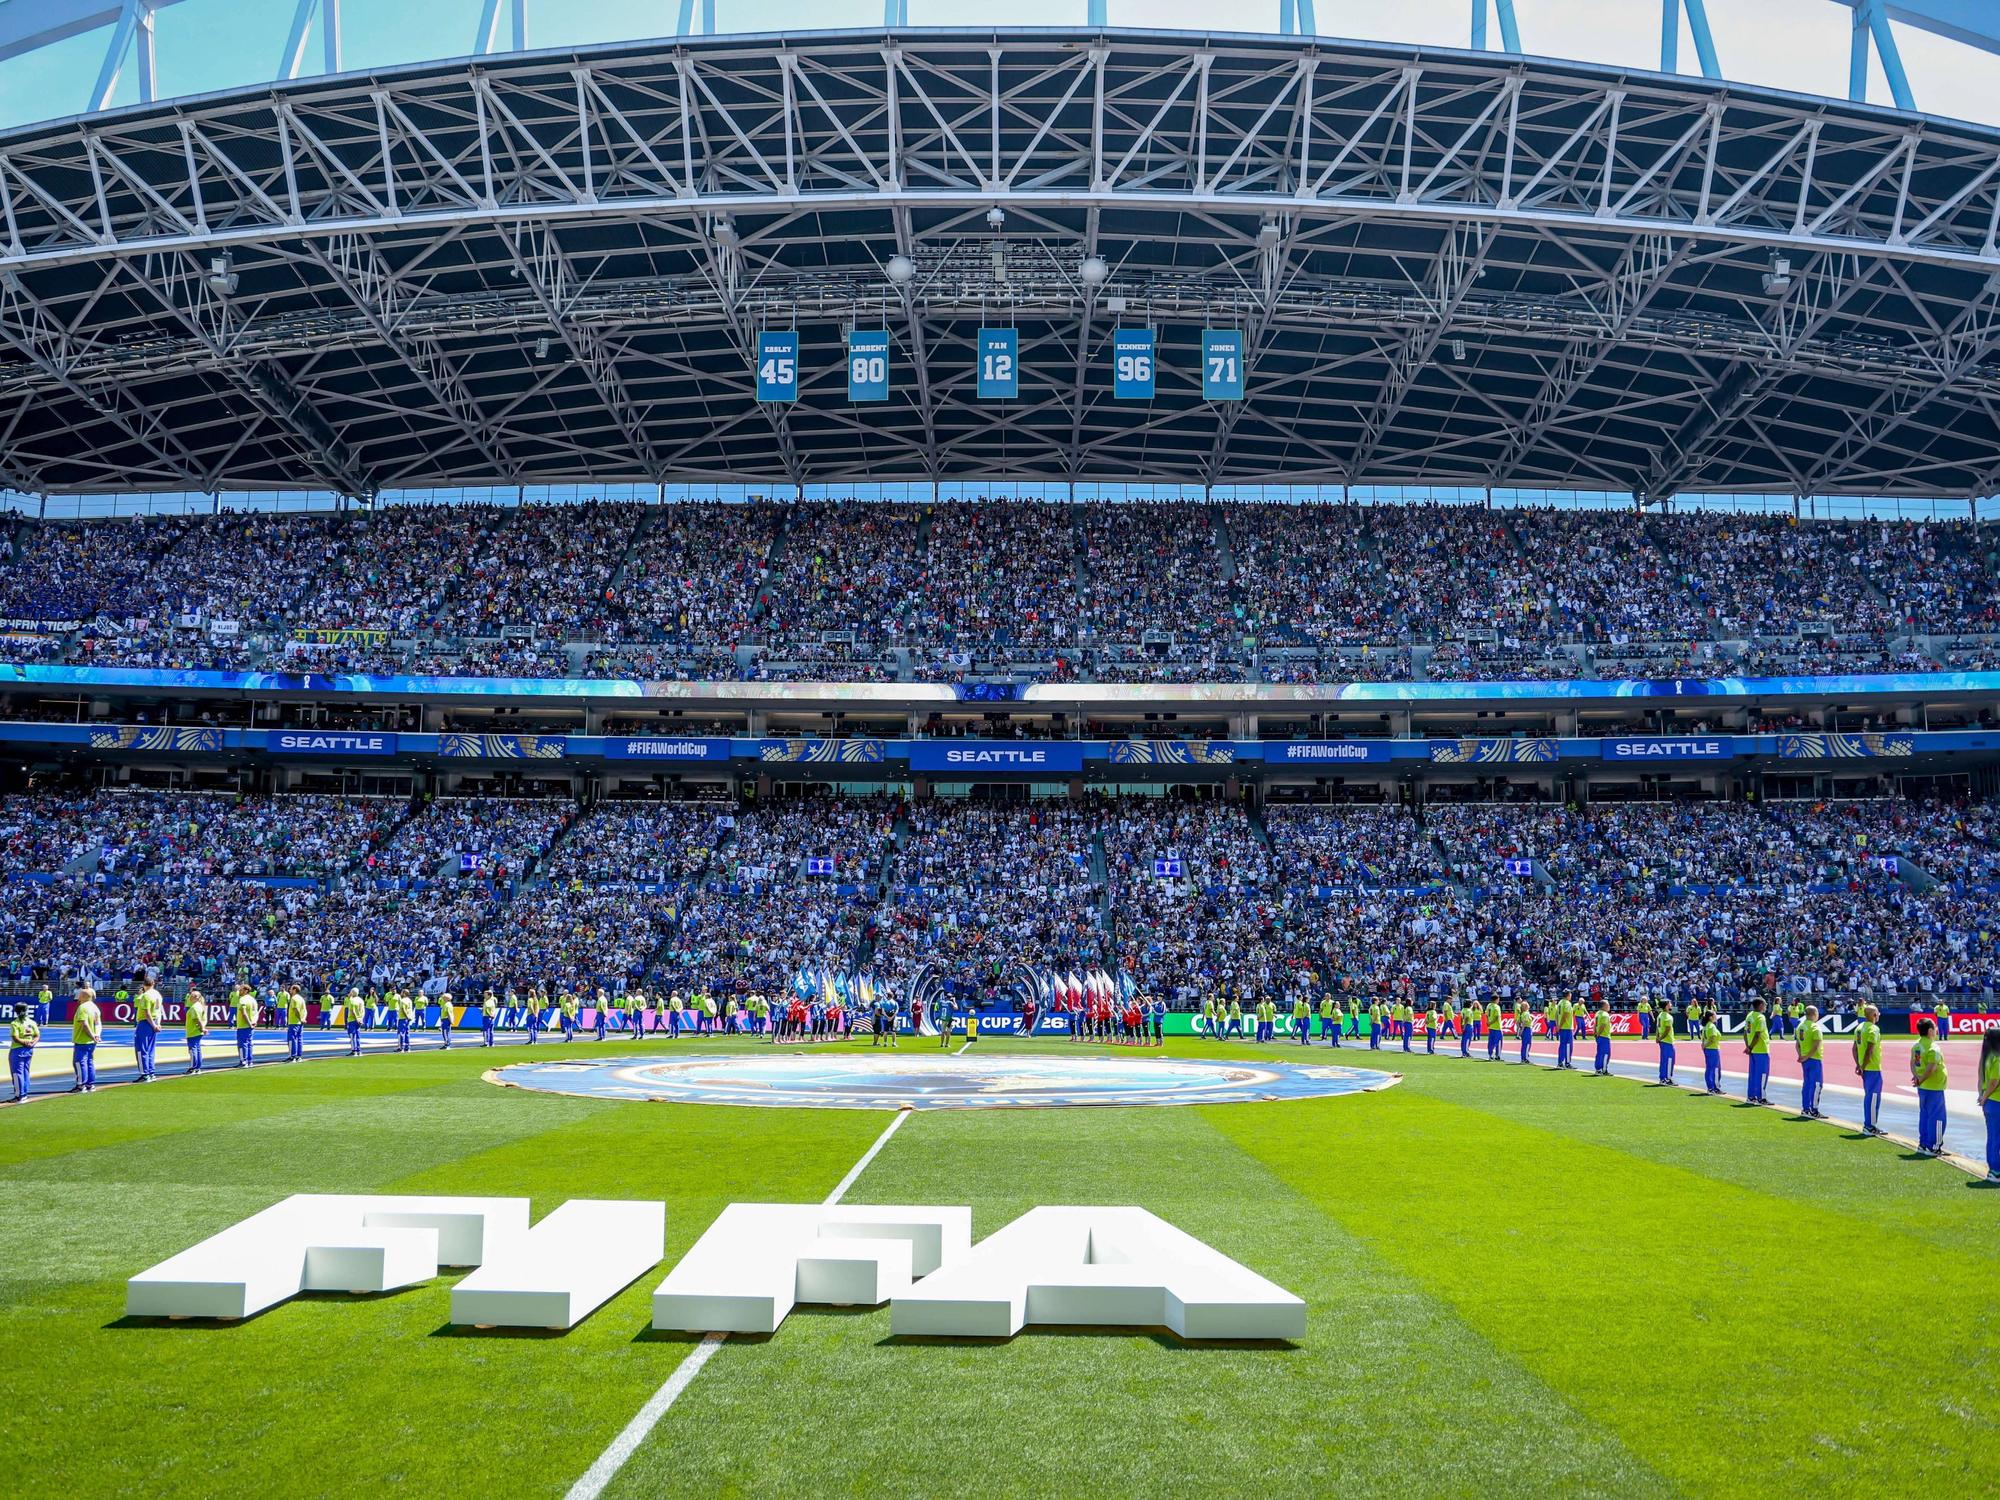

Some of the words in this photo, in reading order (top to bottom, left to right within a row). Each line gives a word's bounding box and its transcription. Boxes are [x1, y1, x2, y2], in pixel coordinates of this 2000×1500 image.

[850, 344, 887, 352] LARGENT
[760, 359, 794, 384] 45
[852, 357, 885, 383] 80
[984, 355, 1012, 380] 12
[1118, 356, 1151, 381] 96
[1208, 357, 1237, 382] 71
[280, 736, 383, 749] SEATTLE
[627, 742, 708, 757] #FIFAWorldCup
[1616, 742, 1719, 755] SEATTLE
[947, 750, 1046, 762] SEATTLE
[1287, 745, 1368, 759] #FIFAWorldCup
[982, 1016, 1011, 1028] CUP
[126, 1193, 1306, 1342] FIFA
